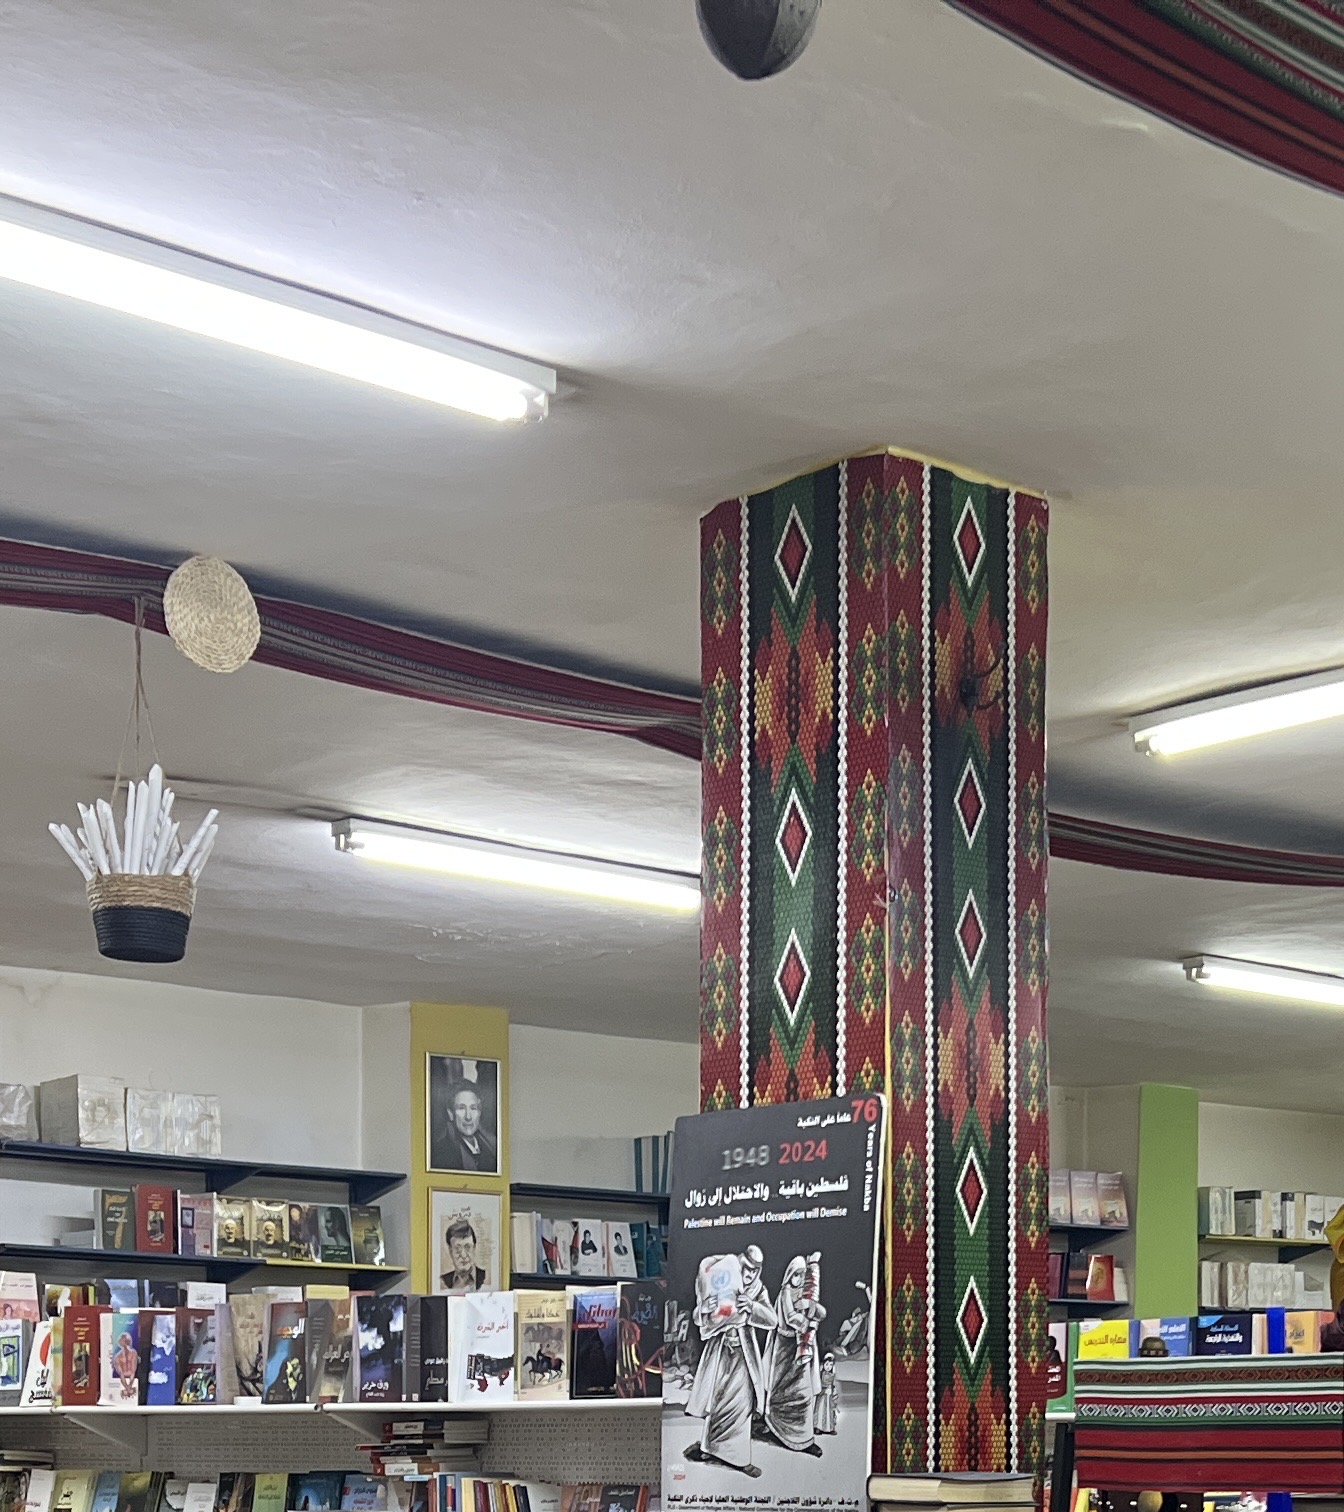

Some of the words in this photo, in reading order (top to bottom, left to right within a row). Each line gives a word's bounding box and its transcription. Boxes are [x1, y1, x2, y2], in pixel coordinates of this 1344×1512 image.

[851, 1099, 879, 1125] 76
[721, 1145, 770, 1170] 1948
[778, 1139, 828, 1165] 2024
[866, 1124, 877, 1161] Years
[866, 1162, 874, 1173] of
[806, 1175, 849, 1197] فلسطين
[863, 1174, 873, 1212] Nakba
[684, 1189, 706, 1209] زوال
[683, 1218, 712, 1229] Palestine
[713, 1216, 725, 1226] will
[726, 1214, 750, 1225] Remain
[752, 1211, 765, 1223] and
[766, 1209, 805, 1224] Occupation
[806, 1208, 818, 1218] will
[820, 1206, 847, 1217] Demise
